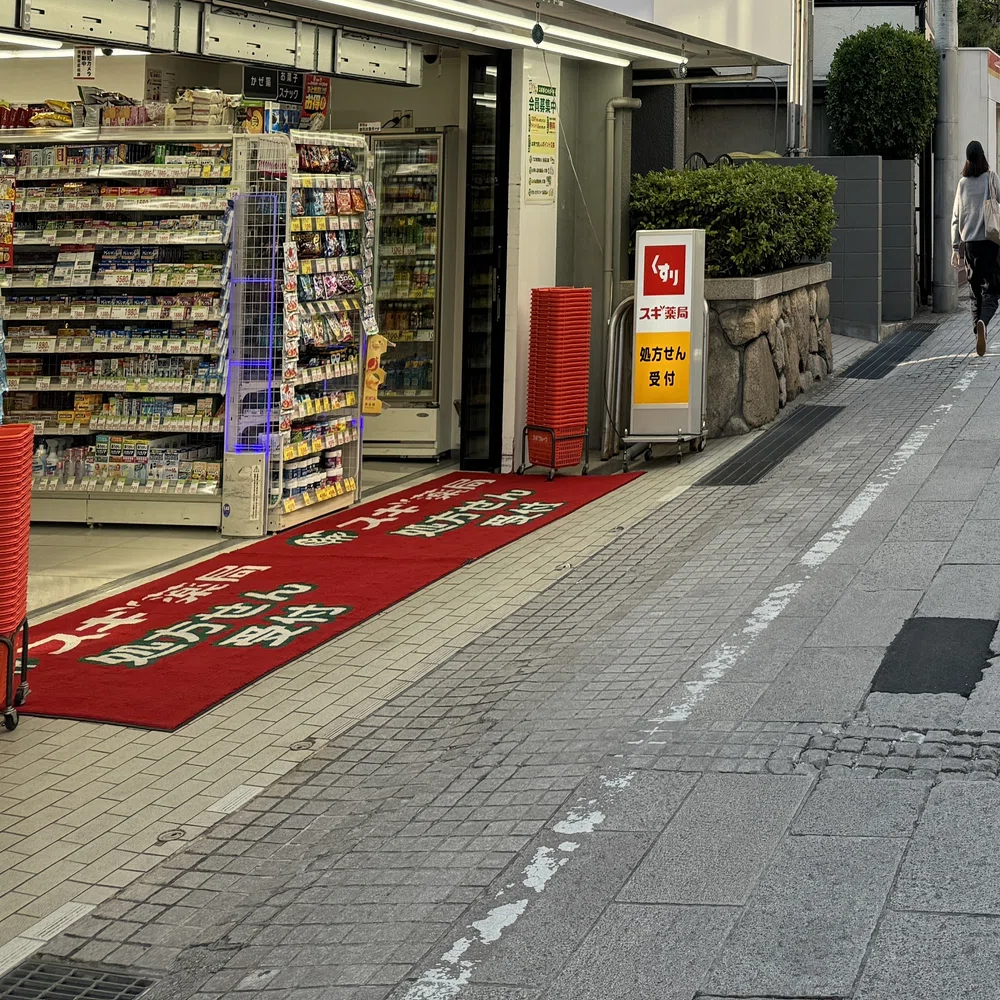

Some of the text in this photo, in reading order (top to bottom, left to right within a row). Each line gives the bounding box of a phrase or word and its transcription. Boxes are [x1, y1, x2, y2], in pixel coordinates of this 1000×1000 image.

[279, 87, 299, 100] スナック
[528, 96, 557, 114] 会員募集中
[651, 254, 679, 286] くすり
[639, 305, 689, 320] スギ薬局
[639, 346, 686, 362] 処方せん
[649, 370, 676, 387] 受付
[337, 479, 497, 530] スギ薬局
[390, 489, 532, 536] 処方せん
[480, 501, 564, 527] 受付
[17, 565, 271, 655] スギ薬局
[85, 583, 313, 667] 処方せん
[218, 604, 341, 648] 受付
